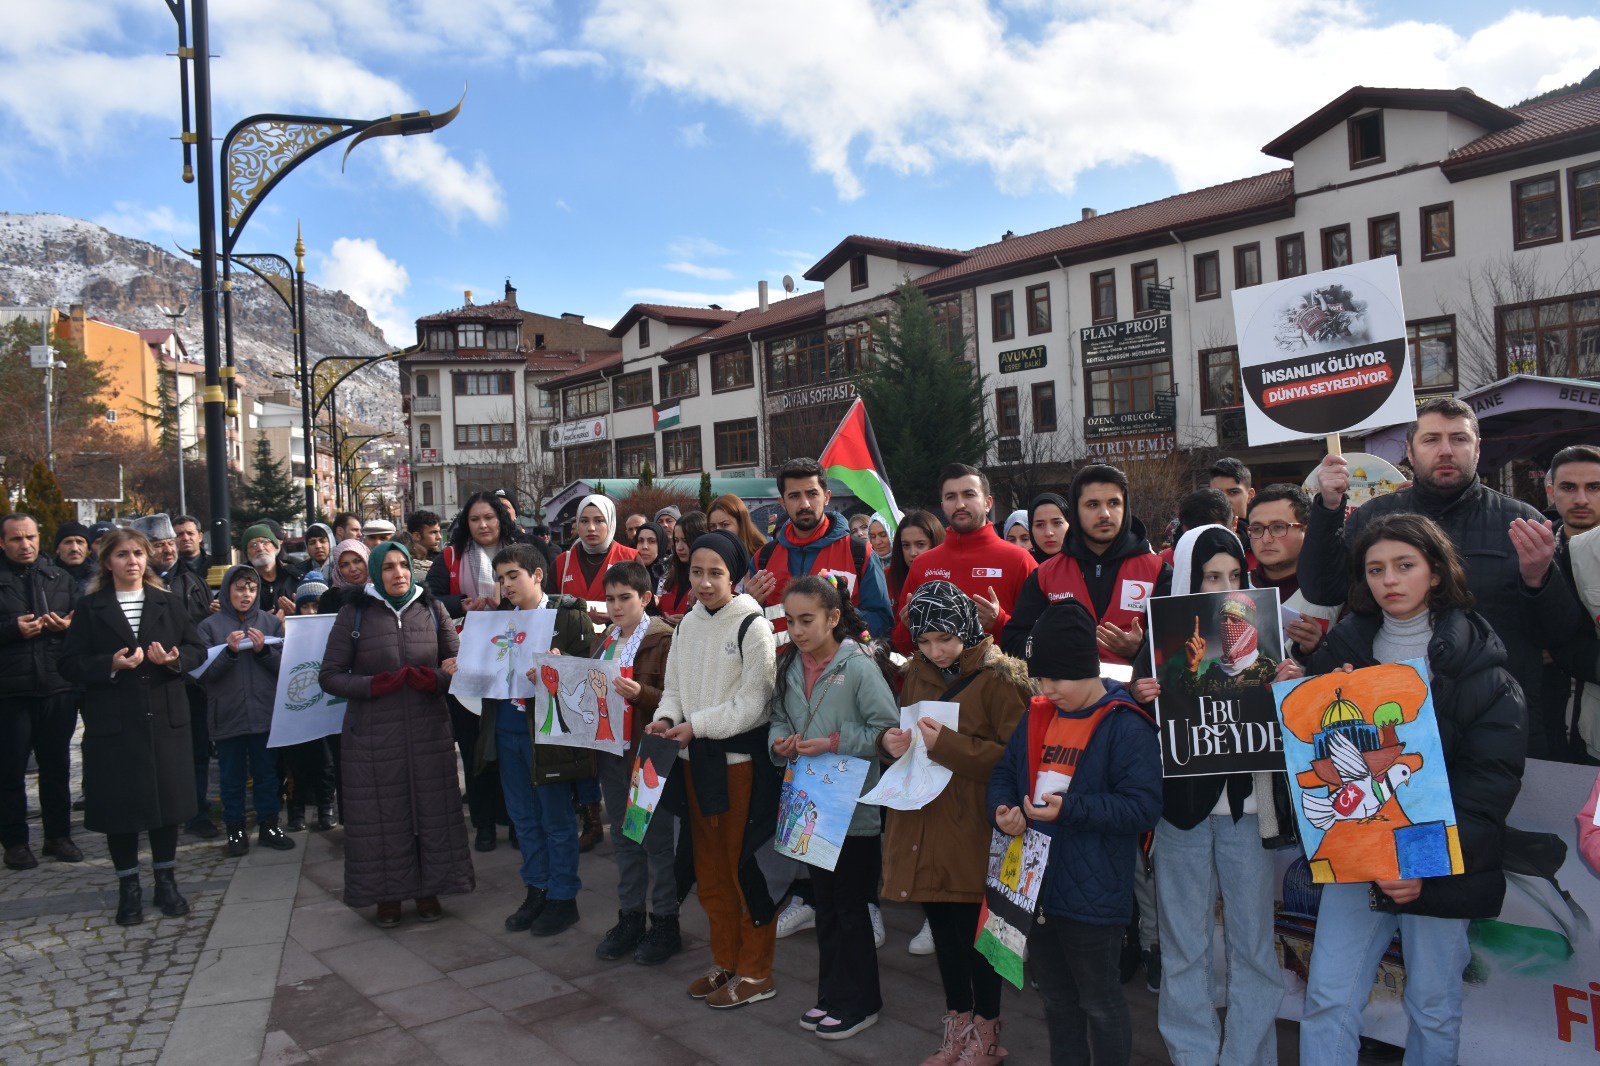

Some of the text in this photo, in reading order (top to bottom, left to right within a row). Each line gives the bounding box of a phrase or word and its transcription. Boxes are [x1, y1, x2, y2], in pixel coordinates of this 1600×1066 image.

[1001, 347, 1044, 364] AVUKAT
[1261, 351, 1387, 384] İNSANLIK ÖLÜYOR
[783, 384, 856, 408] DİVAN SOFRASI 2
[1268, 370, 1388, 403] DÜNYA SEYREDİYOR
[1559, 386, 1600, 406] BELE
[1087, 416, 1116, 426] ÖZENÇ
[1086, 434, 1174, 456] KURUYEMİŞ
[1198, 695, 1241, 734] EBU
